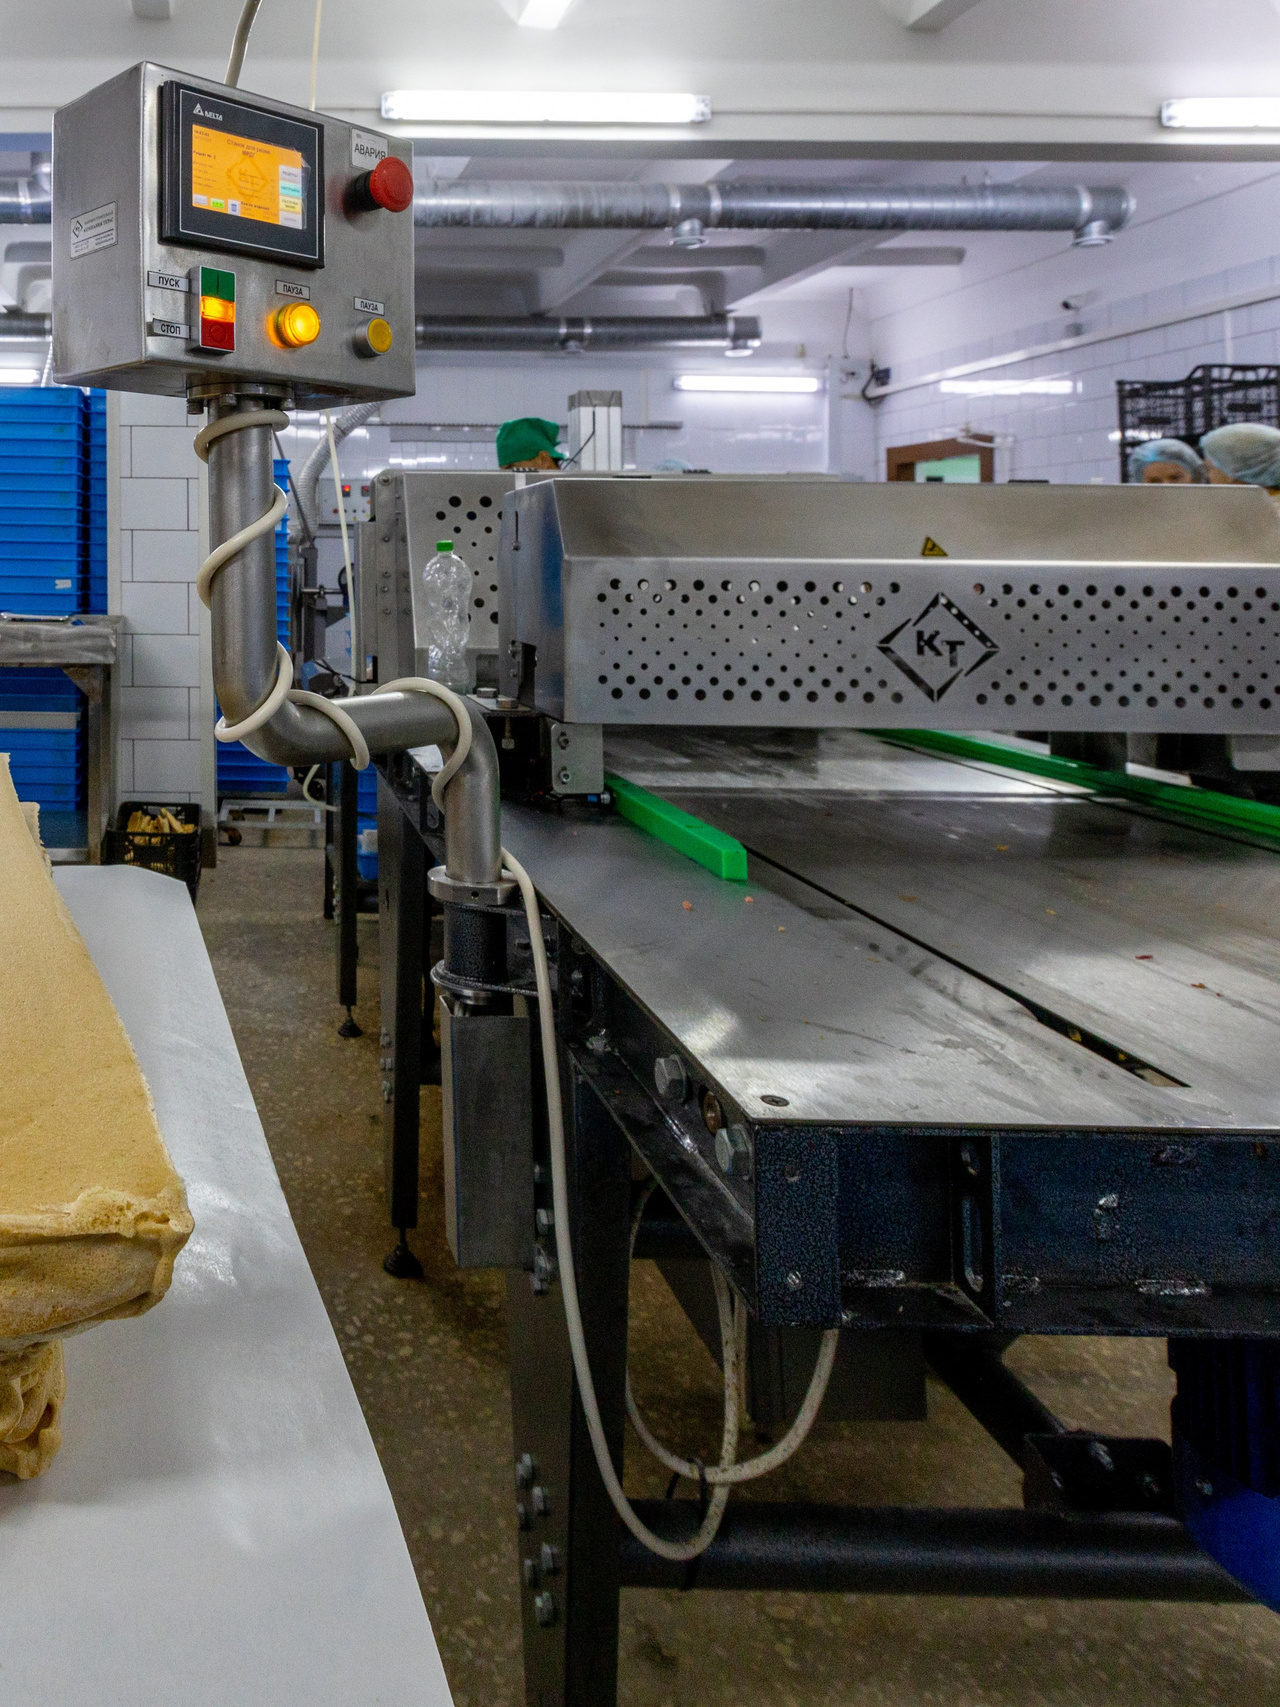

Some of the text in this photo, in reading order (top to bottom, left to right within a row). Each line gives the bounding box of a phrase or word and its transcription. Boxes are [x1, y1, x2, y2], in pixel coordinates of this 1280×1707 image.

[354, 143, 386, 160] АВАРИЯ
[158, 276, 180, 288] ПУСК
[282, 284, 303, 296] ПАУЗА
[360, 300, 379, 312] ПАУЗА
[160, 323, 181, 335] СТОП
